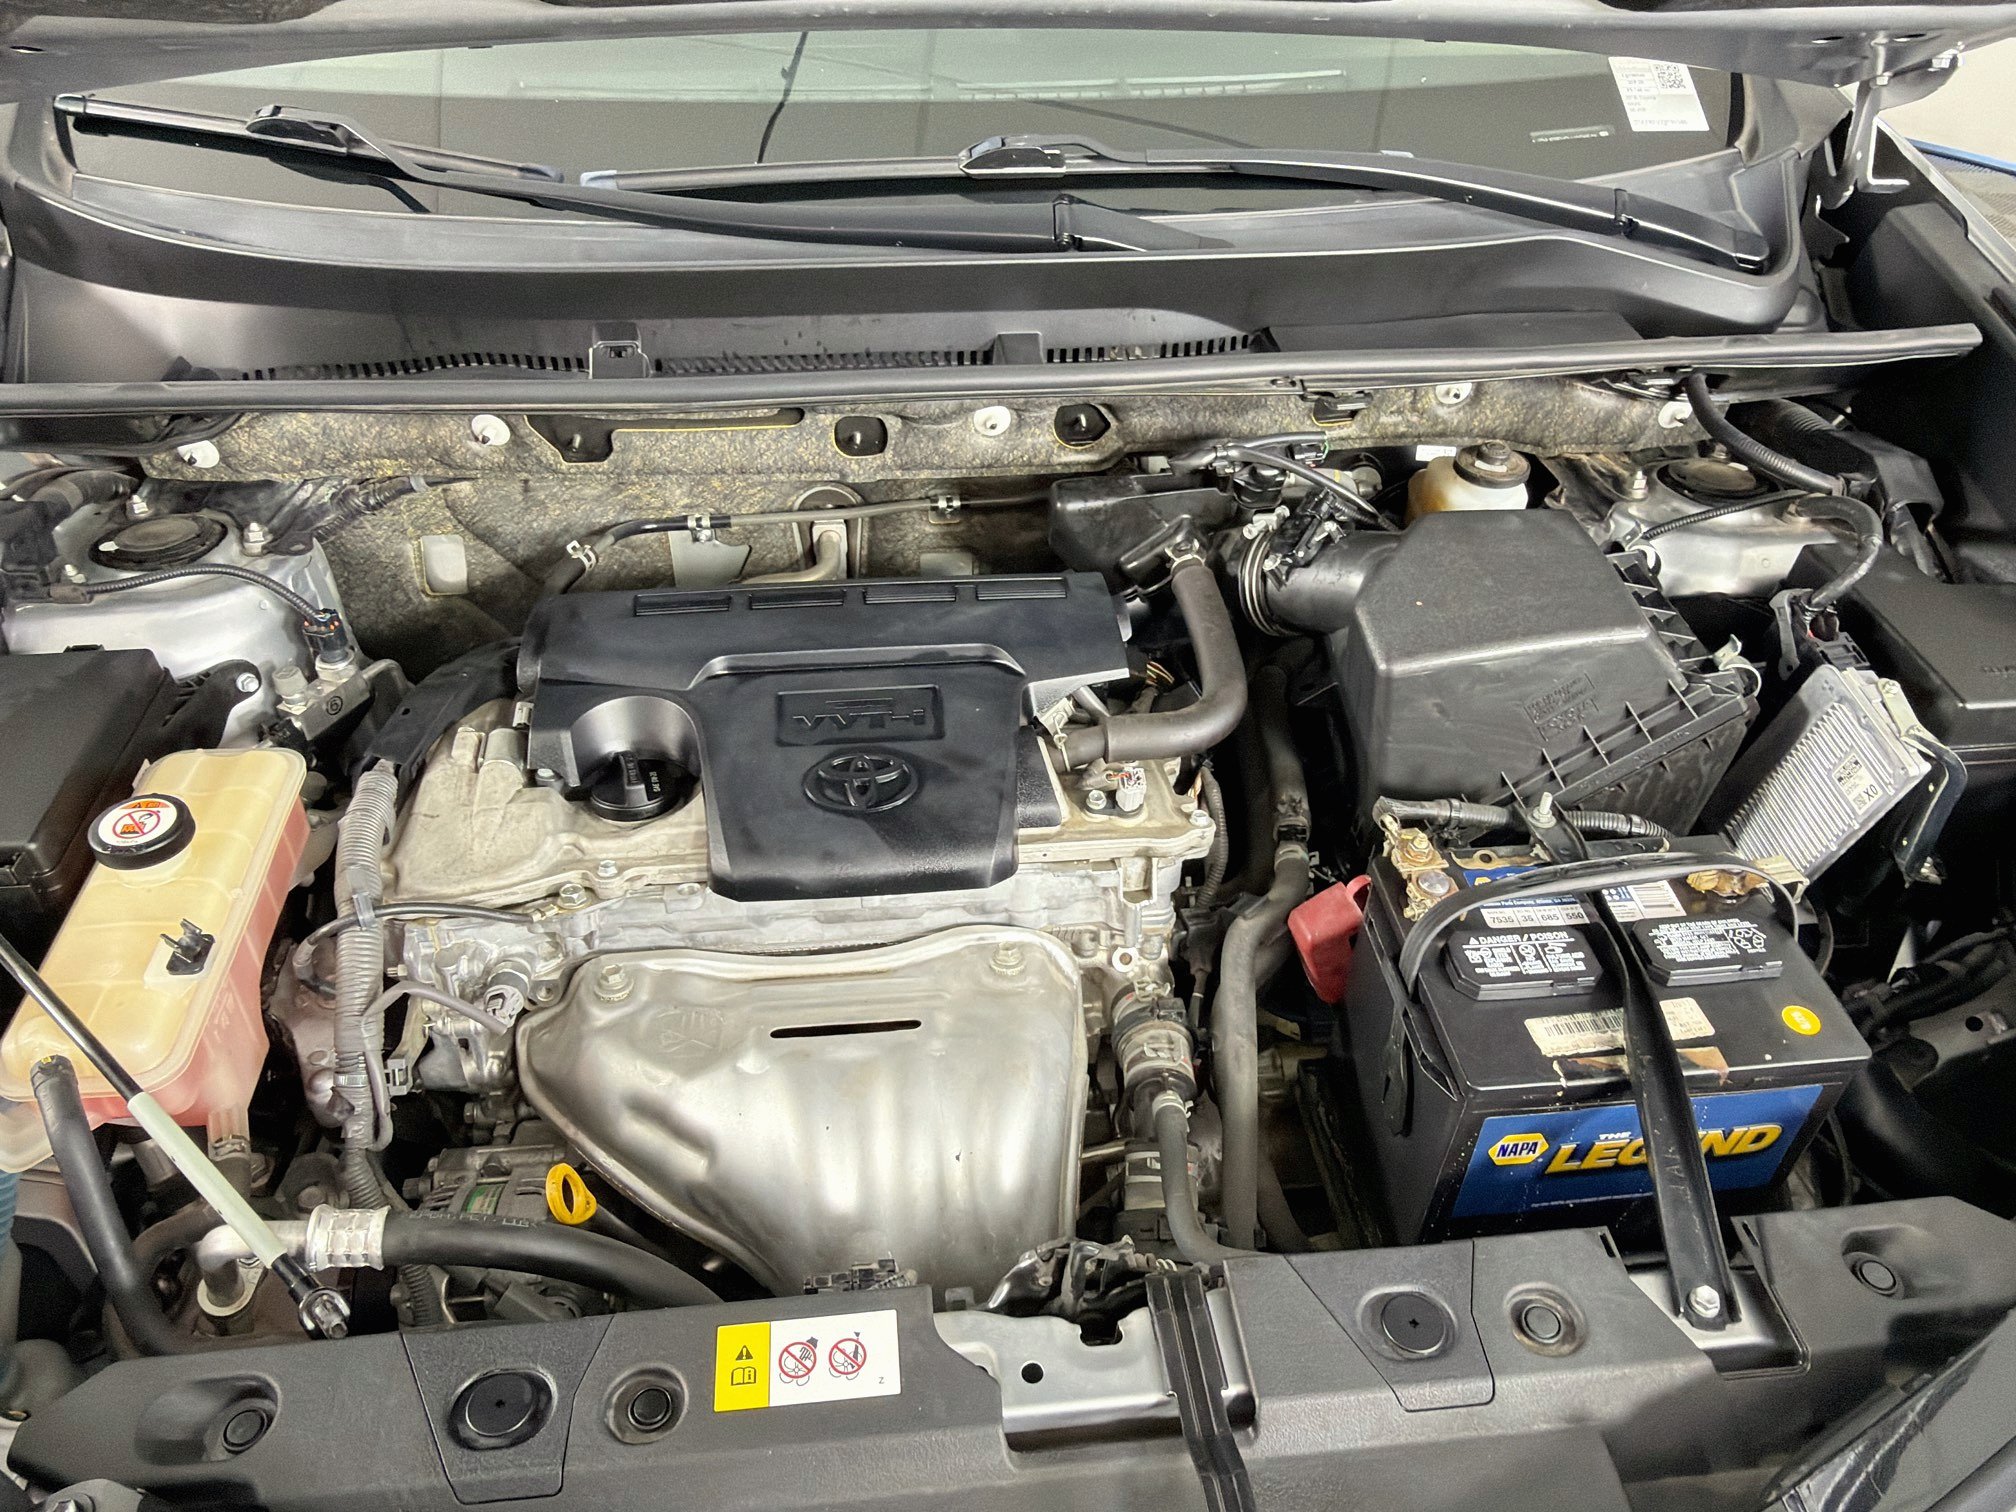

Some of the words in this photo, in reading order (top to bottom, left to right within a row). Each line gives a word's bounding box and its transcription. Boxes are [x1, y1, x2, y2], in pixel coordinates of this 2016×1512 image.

[1541, 913, 1560, 921] 685
[1565, 911, 1585, 920] 550
[1478, 934, 1522, 945] DANGER
[1529, 931, 1569, 942] POISON
[1598, 1131, 1633, 1140] THE
[1496, 1141, 1539, 1158] NAPA
[1544, 1123, 1783, 1175] LEGND
